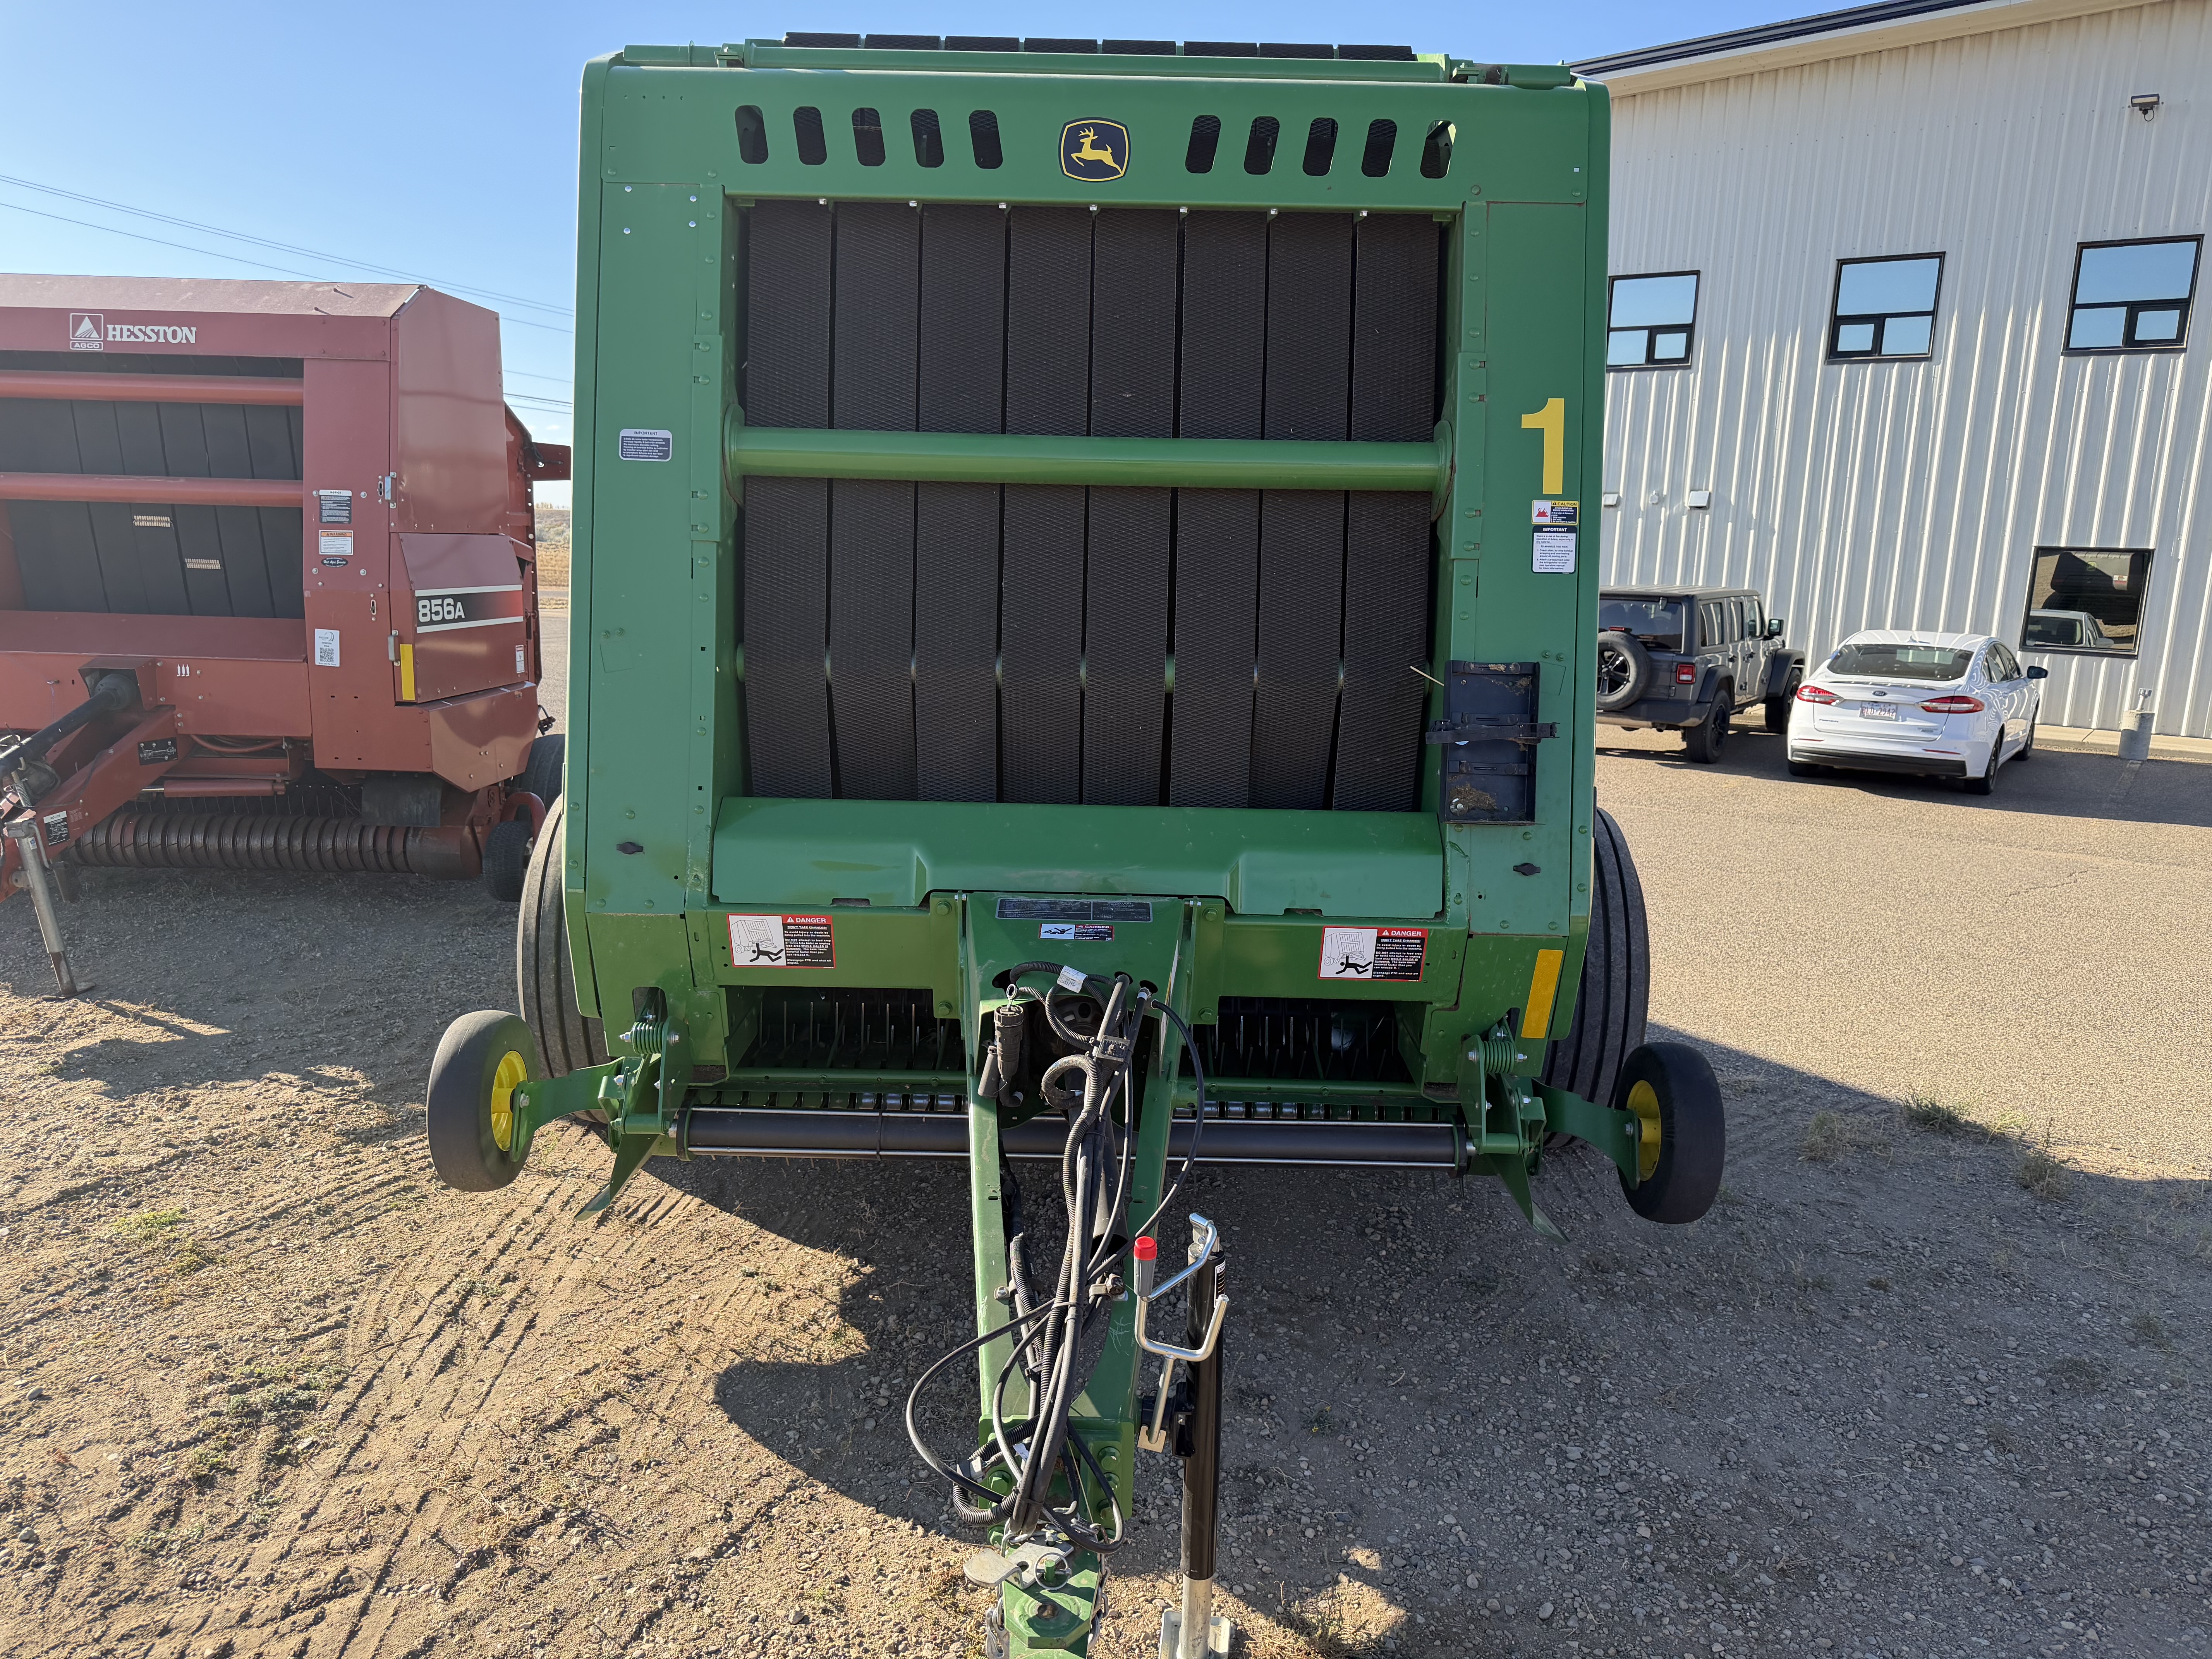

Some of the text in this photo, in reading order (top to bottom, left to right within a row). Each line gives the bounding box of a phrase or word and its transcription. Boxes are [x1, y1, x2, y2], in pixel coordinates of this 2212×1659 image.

[107, 325, 196, 343] HESSTON
[1522, 398, 1565, 494] 1
[418, 598, 465, 622] 856A
